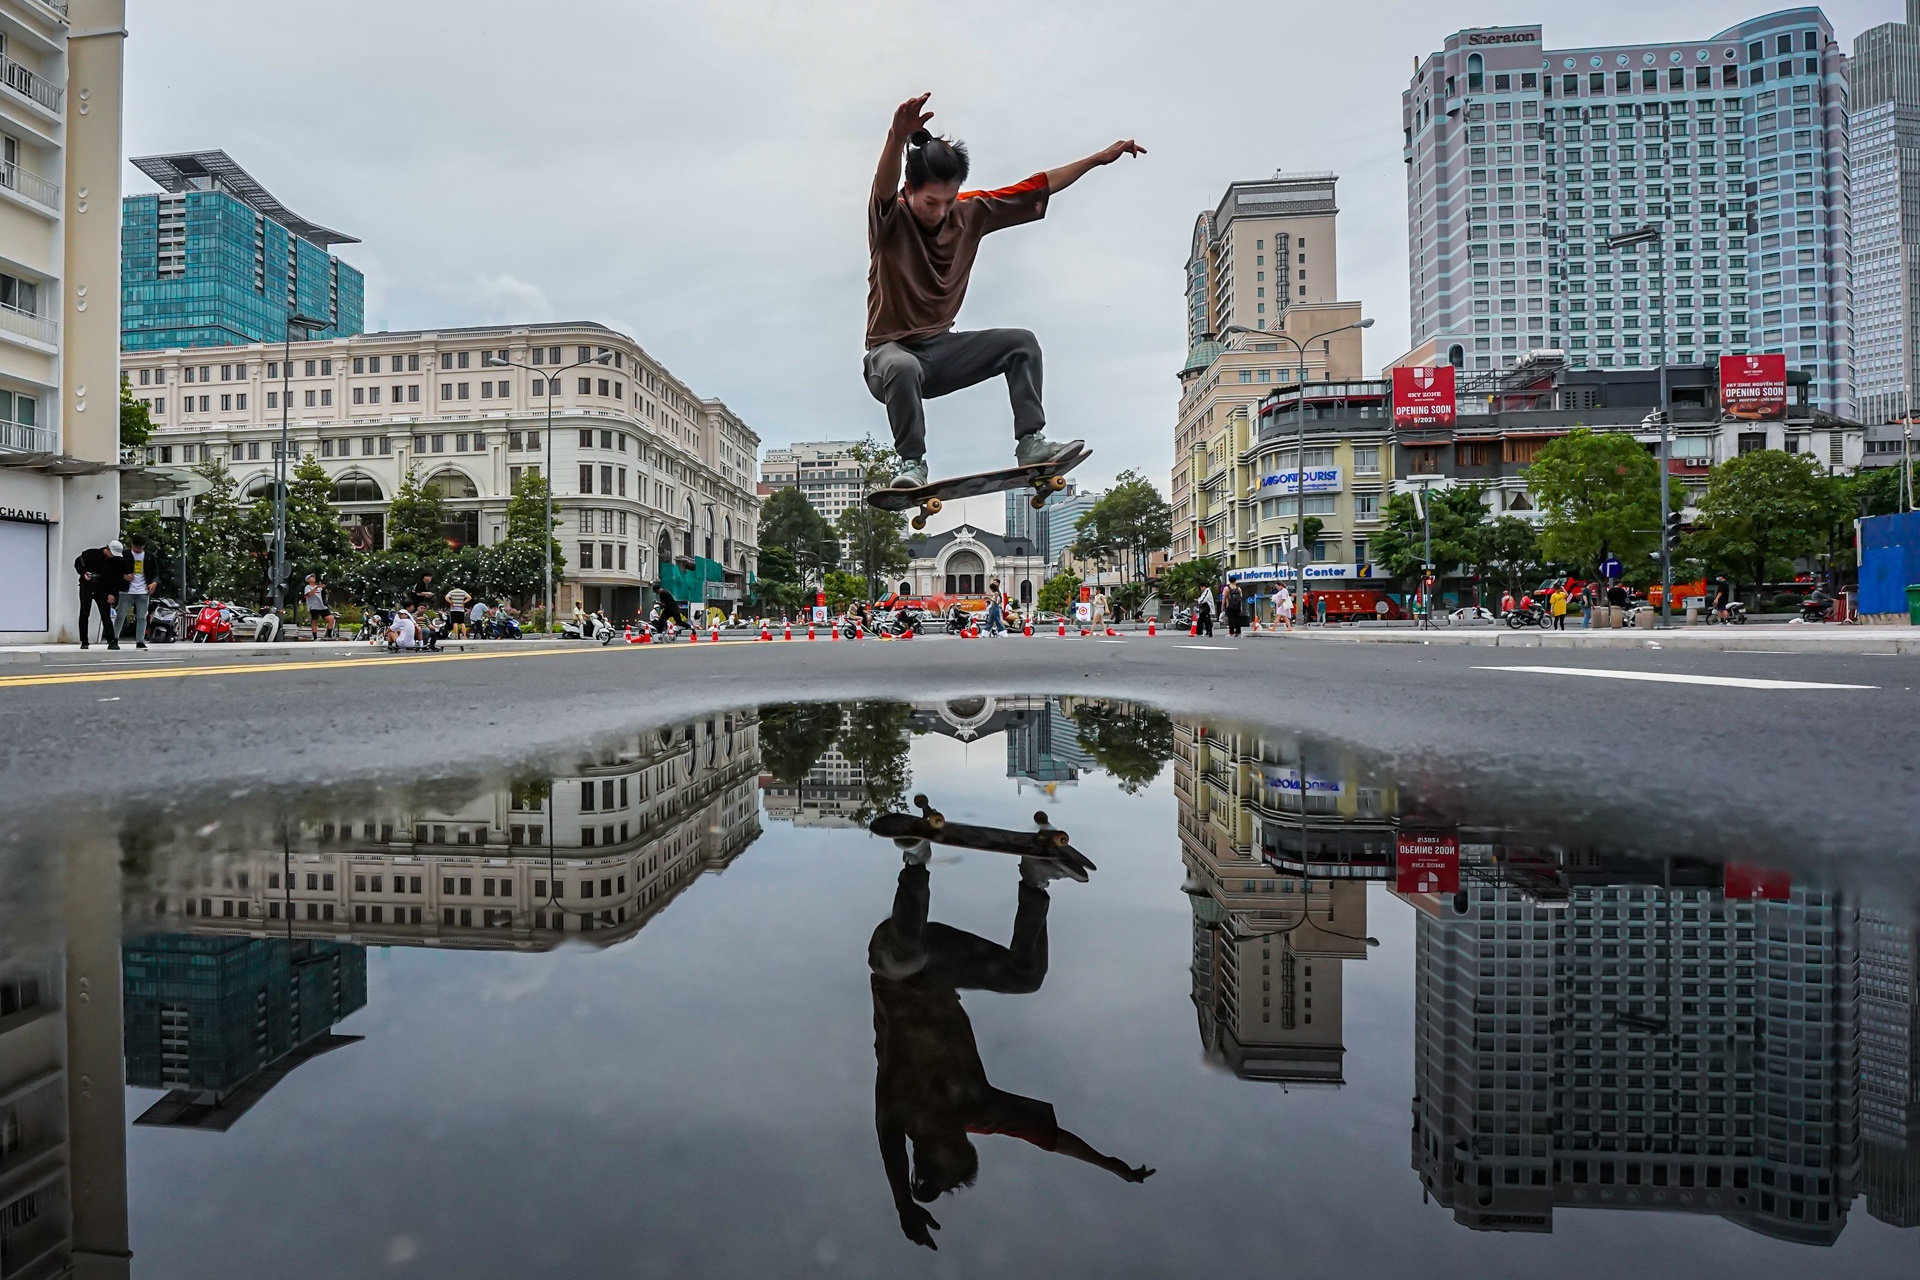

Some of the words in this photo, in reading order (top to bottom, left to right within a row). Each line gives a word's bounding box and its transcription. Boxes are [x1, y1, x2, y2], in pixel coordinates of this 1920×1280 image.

[1469, 32, 1535, 45] Sheraton
[1726, 388, 1760, 397] OPENING
[1762, 387, 1784, 396] SOON
[1396, 406, 1429, 416] OPENING
[1431, 404, 1452, 414] SOON
[0, 506, 50, 521] CHANEL
[1305, 567, 1346, 576] Center
